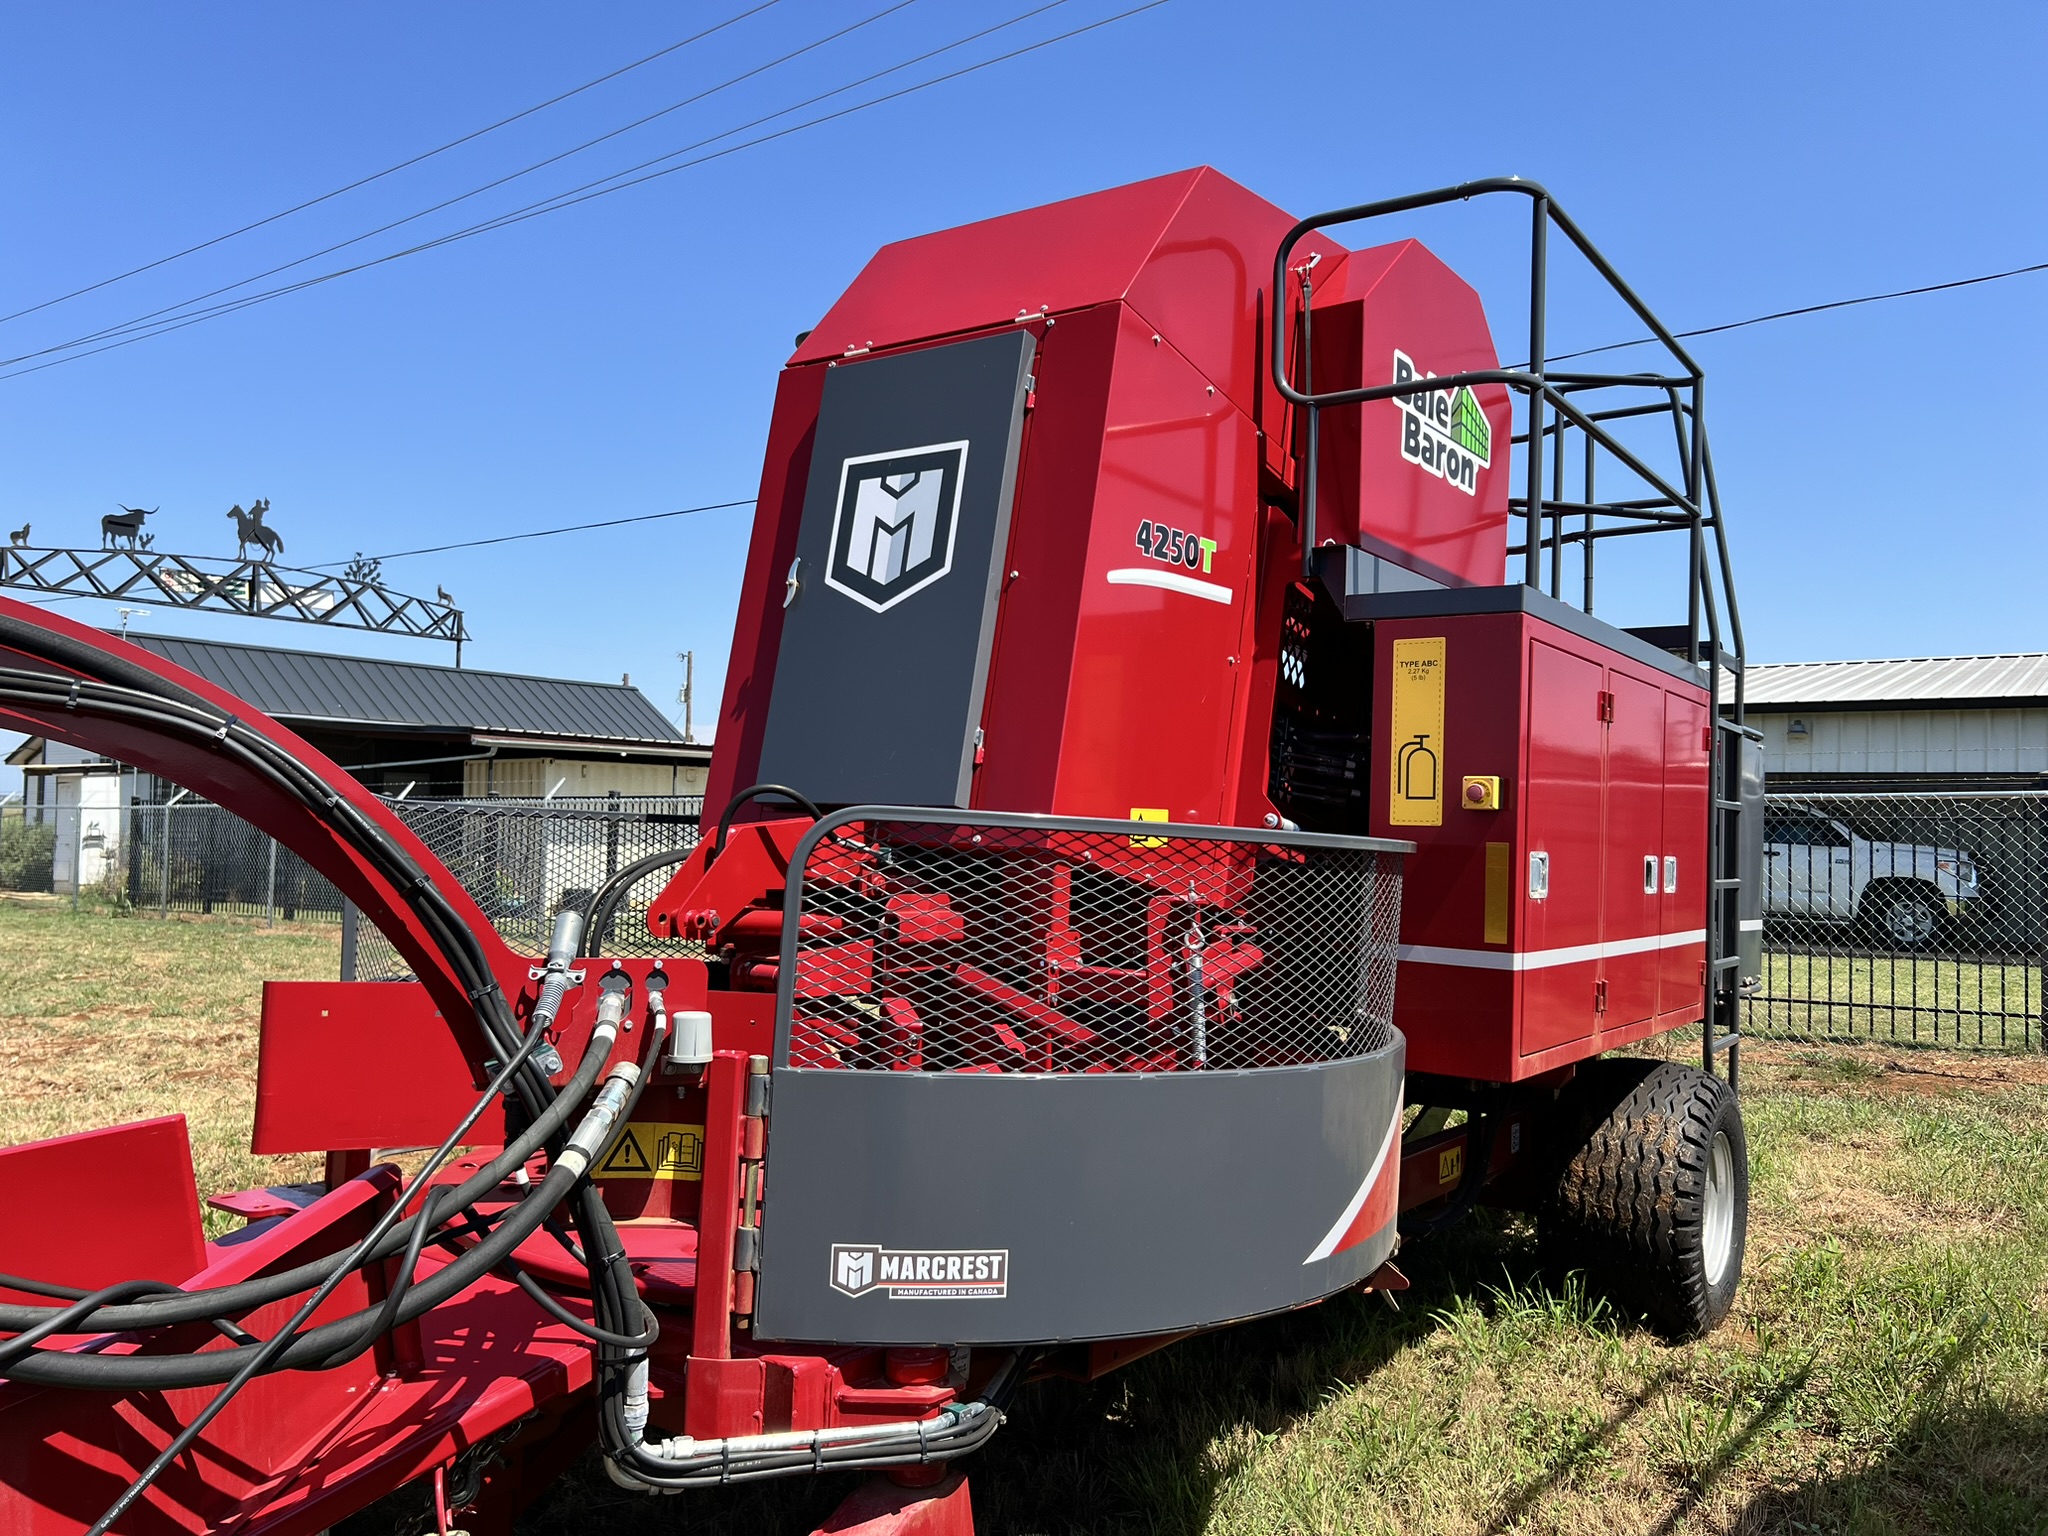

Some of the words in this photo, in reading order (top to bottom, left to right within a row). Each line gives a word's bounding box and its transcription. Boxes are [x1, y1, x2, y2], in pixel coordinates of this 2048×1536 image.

[1404, 410, 1475, 490] Baron
[1136, 519, 1217, 574] 4250T
[880, 1255, 1002, 1280] MARCREST
[897, 1288, 957, 1296] MANUFACTURED
[967, 1287, 998, 1295] CANADA
[145, 1464, 160, 1480] CABLE
